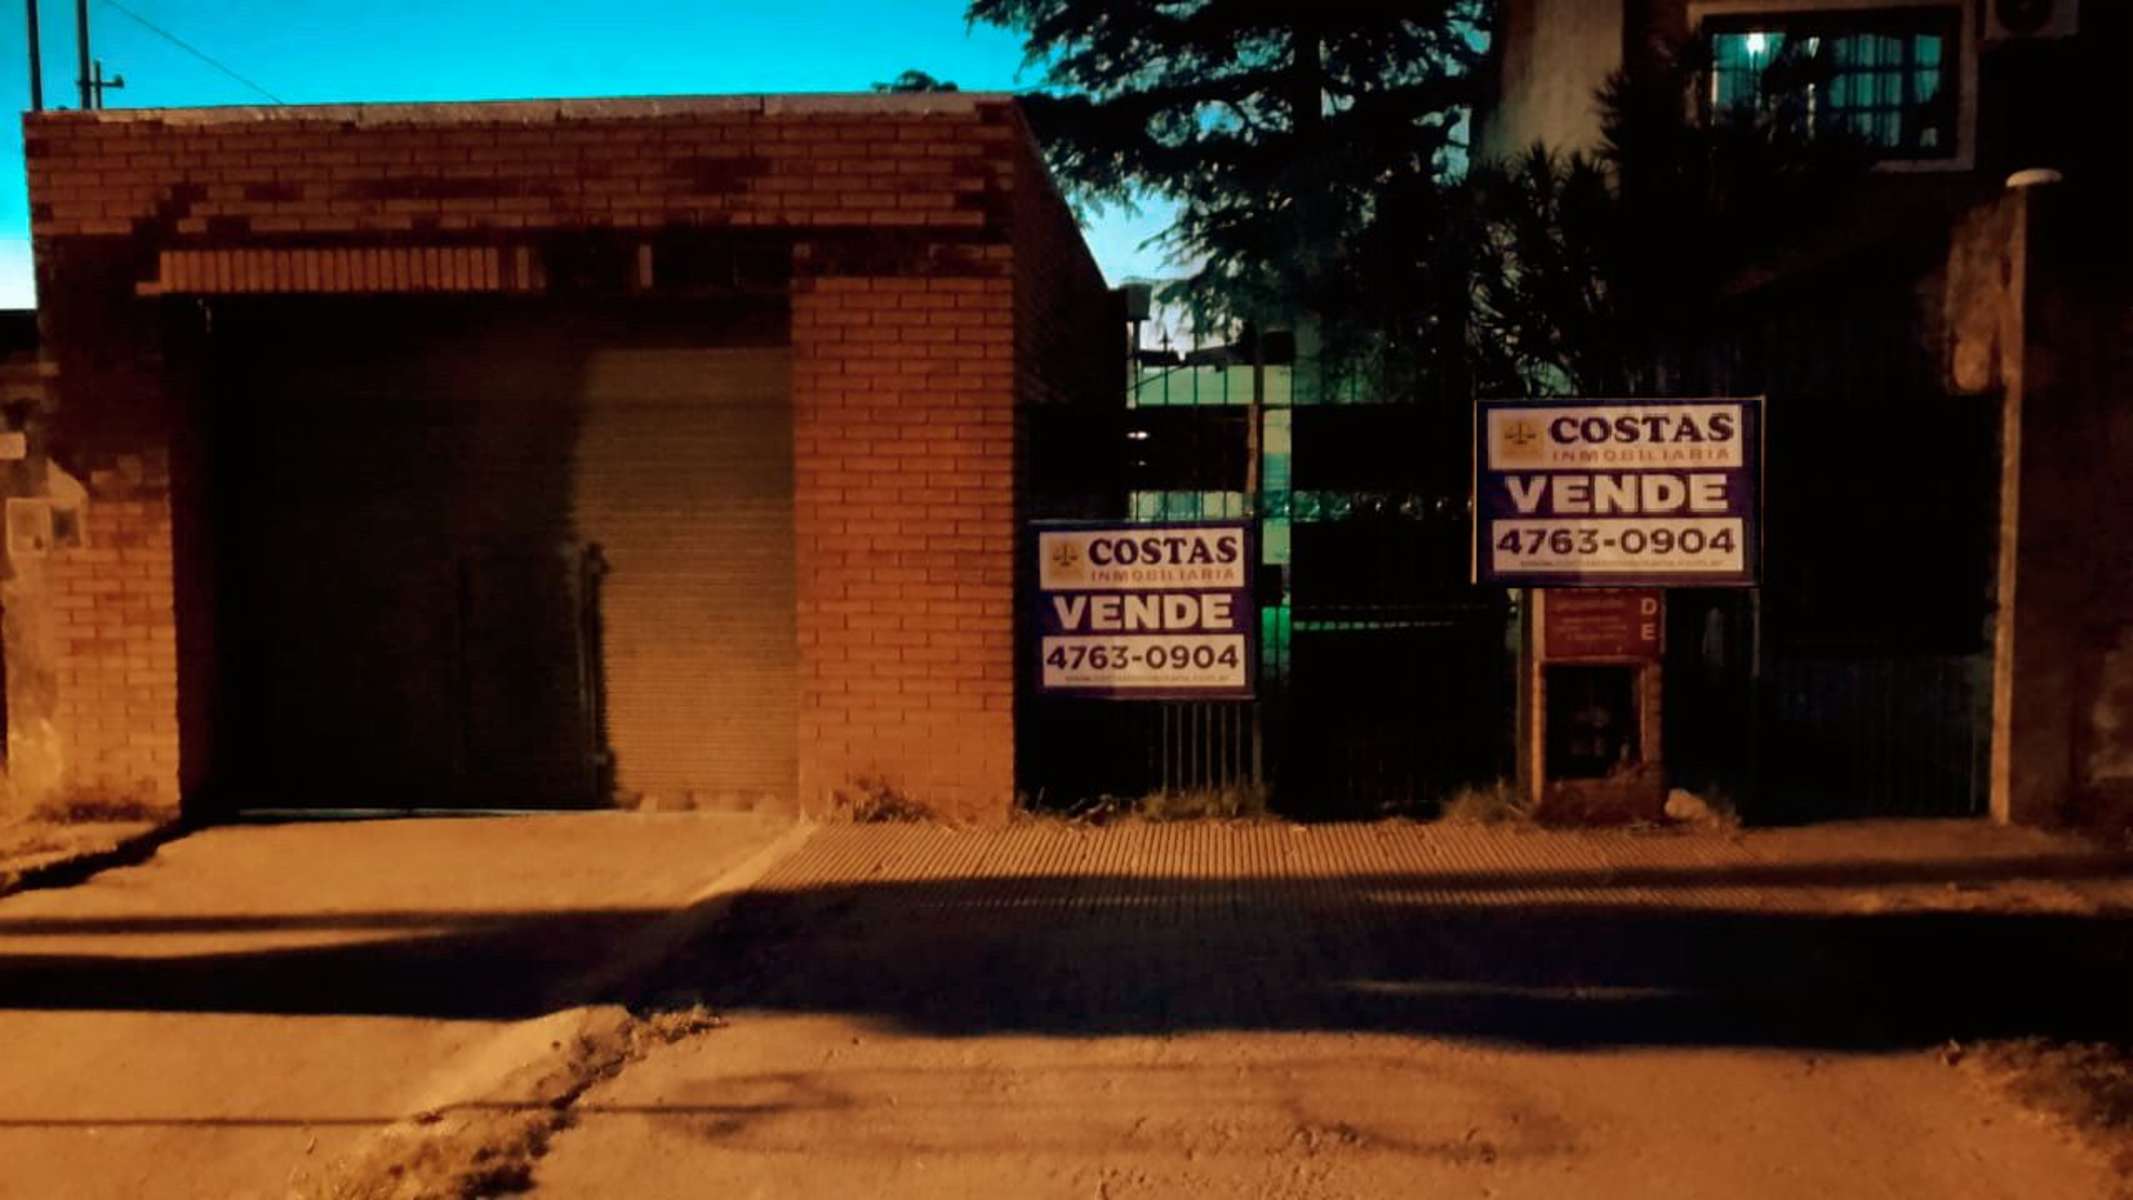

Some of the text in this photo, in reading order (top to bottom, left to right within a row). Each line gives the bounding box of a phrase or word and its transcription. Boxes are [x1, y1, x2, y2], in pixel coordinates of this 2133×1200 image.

[1548, 412, 1735, 445] COSTAS
[1552, 448, 1731, 463] INMOBILIARIA
[1504, 473, 1729, 513] VENDE
[1088, 536, 1238, 566] COSTAS
[1496, 528, 1736, 555] 4763-0904
[1091, 568, 1236, 582] INMOBILIARIA
[1053, 593, 1234, 630] VENDE
[1046, 644, 1239, 670] 4763-0904
